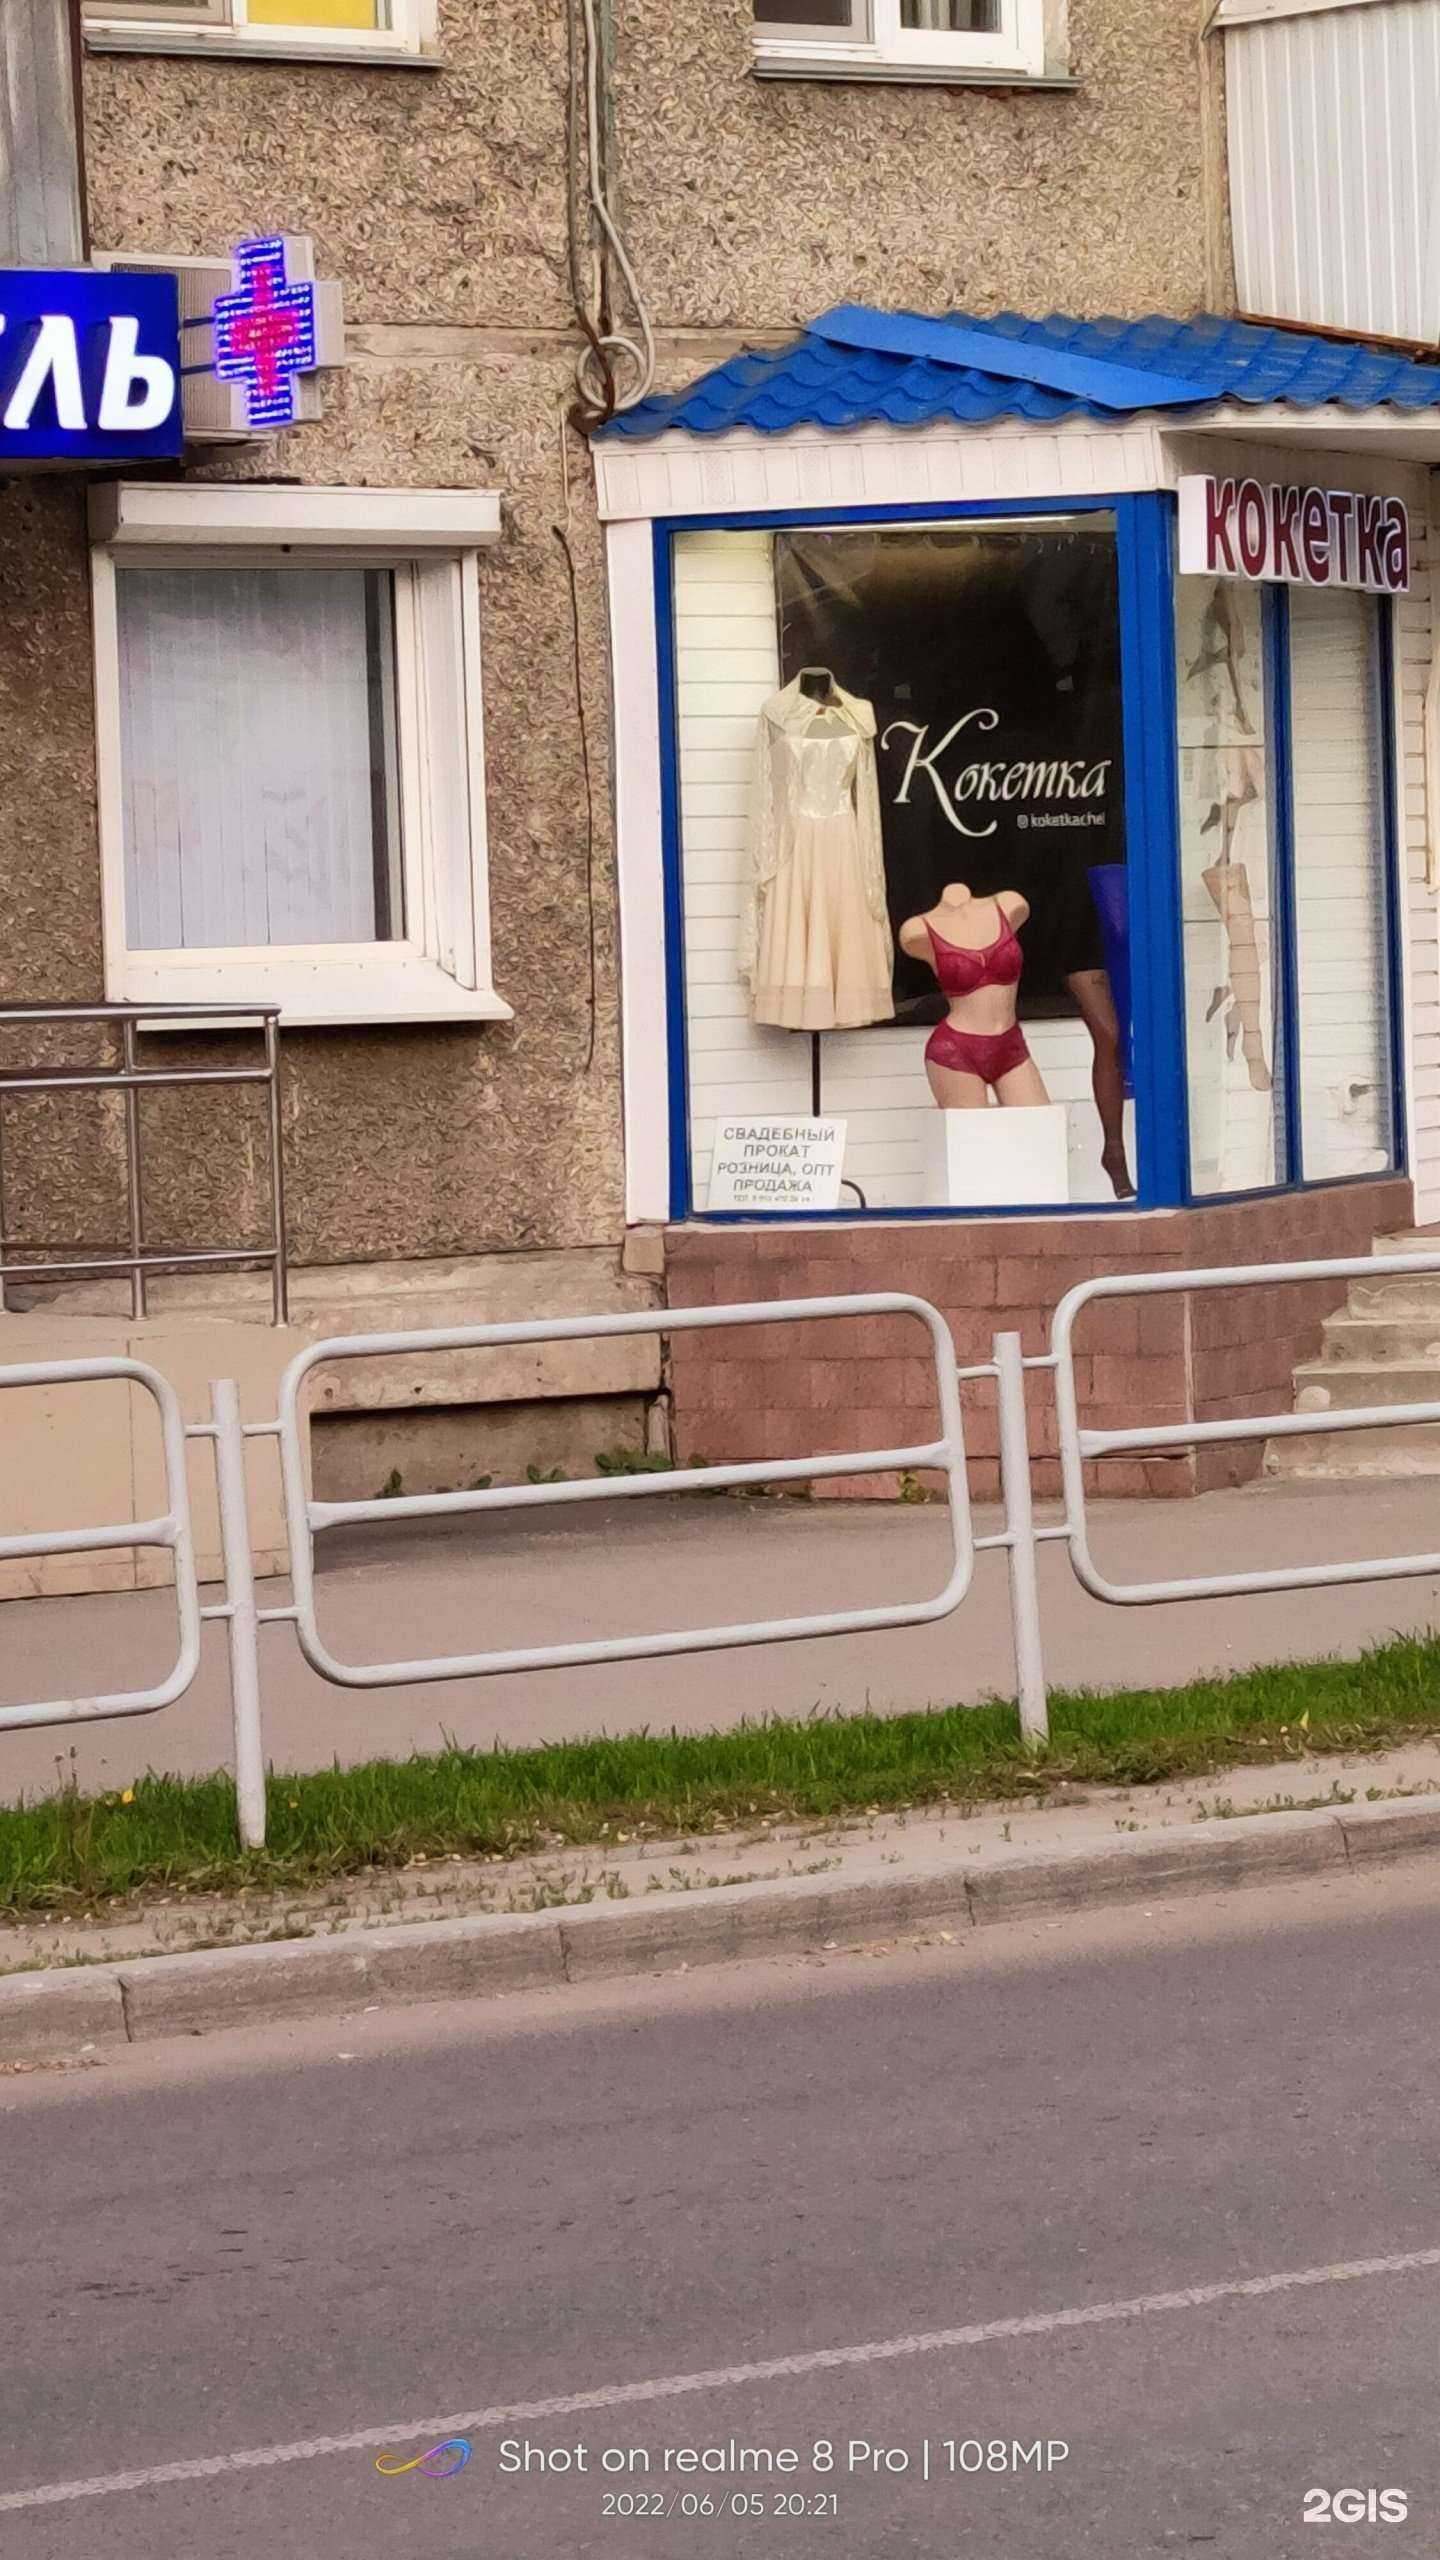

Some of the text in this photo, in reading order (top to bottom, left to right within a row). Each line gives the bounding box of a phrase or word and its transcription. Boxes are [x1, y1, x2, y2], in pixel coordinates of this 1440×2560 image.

[0, 313, 175, 431] ЛЬ
[881, 708, 1112, 838] Кокетка
[723, 1126, 835, 1142] СВАДЕБНЫЙ
[743, 1144, 812, 1158] ПРОКАТ
[717, 1162, 835, 1177] РОЗНИЦА, ОПТ
[733, 1179, 813, 1192] ПРОДАЖА
